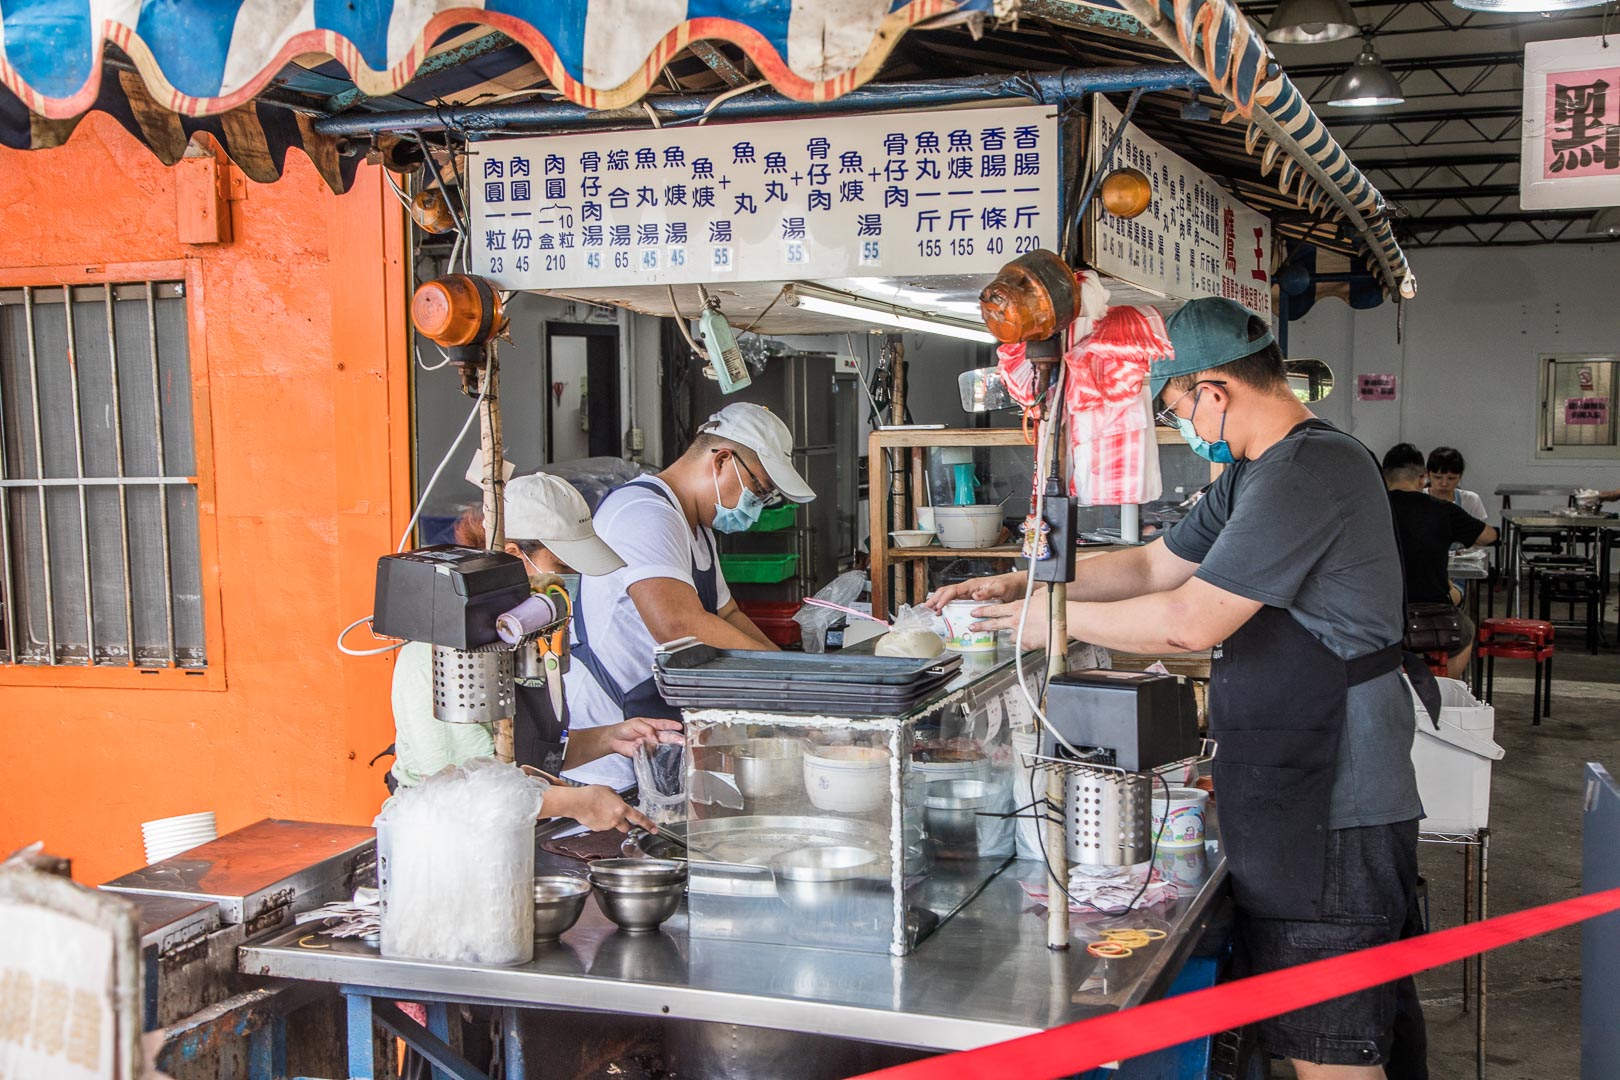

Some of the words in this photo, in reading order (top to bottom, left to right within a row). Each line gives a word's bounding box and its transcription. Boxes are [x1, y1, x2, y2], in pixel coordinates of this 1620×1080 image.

[544, 154, 565, 200] 肉圓
[915, 131, 941, 232] 魚丸一斤
[980, 127, 1007, 230] 香腸一條
[1013, 125, 1040, 229] 香腸一斤
[484, 158, 506, 251] 肉圓一粒
[510, 156, 532, 250] 肉圓一份
[580, 151, 603, 246] 骨仔肉湯
[607, 149, 631, 246] 綜合湯
[635, 147, 659, 245] 魚丸湯
[709, 220, 732, 243] 湯
[782, 217, 806, 240] 湯
[857, 214, 882, 236] 湯
[787, 245, 802, 261] 55
[864, 242, 879, 259] 55
[918, 239, 942, 257] 155
[950, 238, 974, 256] 155
[987, 237, 1003, 254] 40
[1015, 235, 1040, 253] 220
[490, 257, 503, 273] 23
[516, 256, 529, 272] 45
[546, 254, 566, 271] 210
[588, 252, 600, 269] 45
[615, 252, 629, 268] 65
[644, 251, 657, 267] 45
[671, 250, 684, 266] 45
[714, 248, 728, 264] 55
